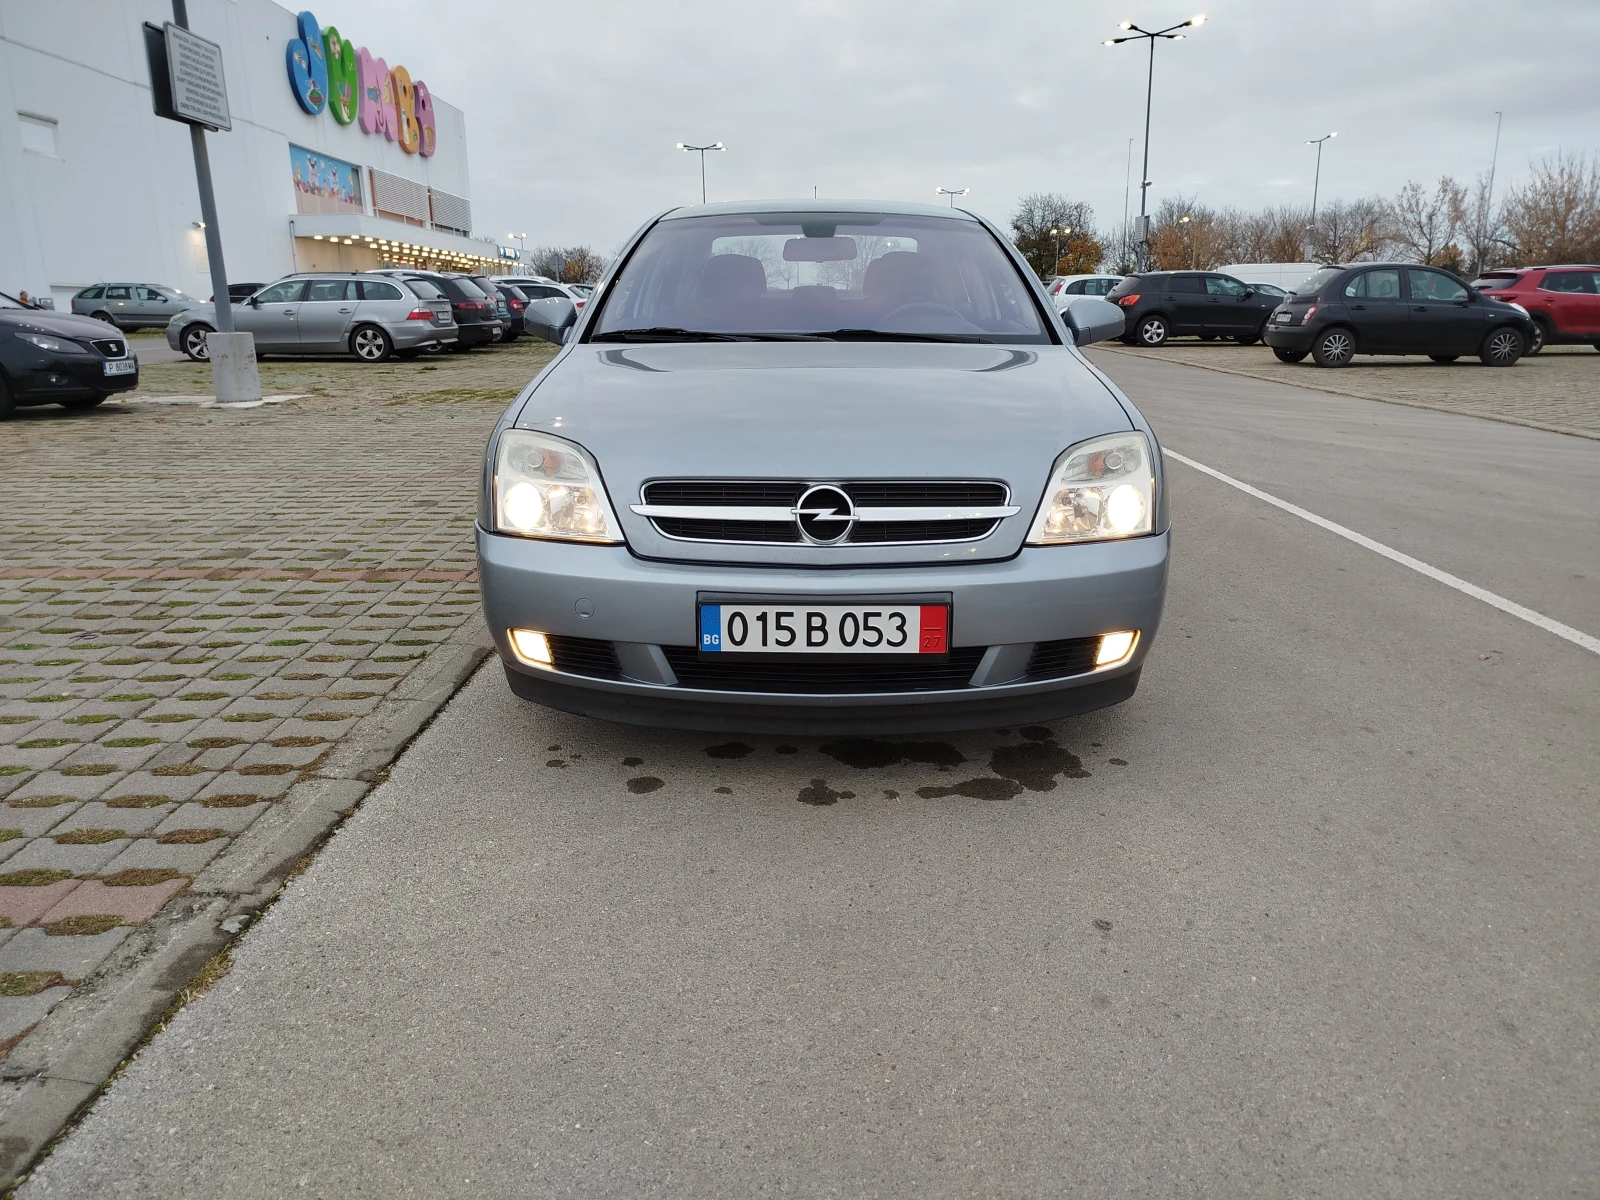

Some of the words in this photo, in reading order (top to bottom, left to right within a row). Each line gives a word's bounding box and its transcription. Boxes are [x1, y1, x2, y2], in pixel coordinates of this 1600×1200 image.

[703, 634, 719, 645] BG
[727, 611, 796, 647] 015
[806, 612, 829, 646] B
[838, 611, 908, 648] 053
